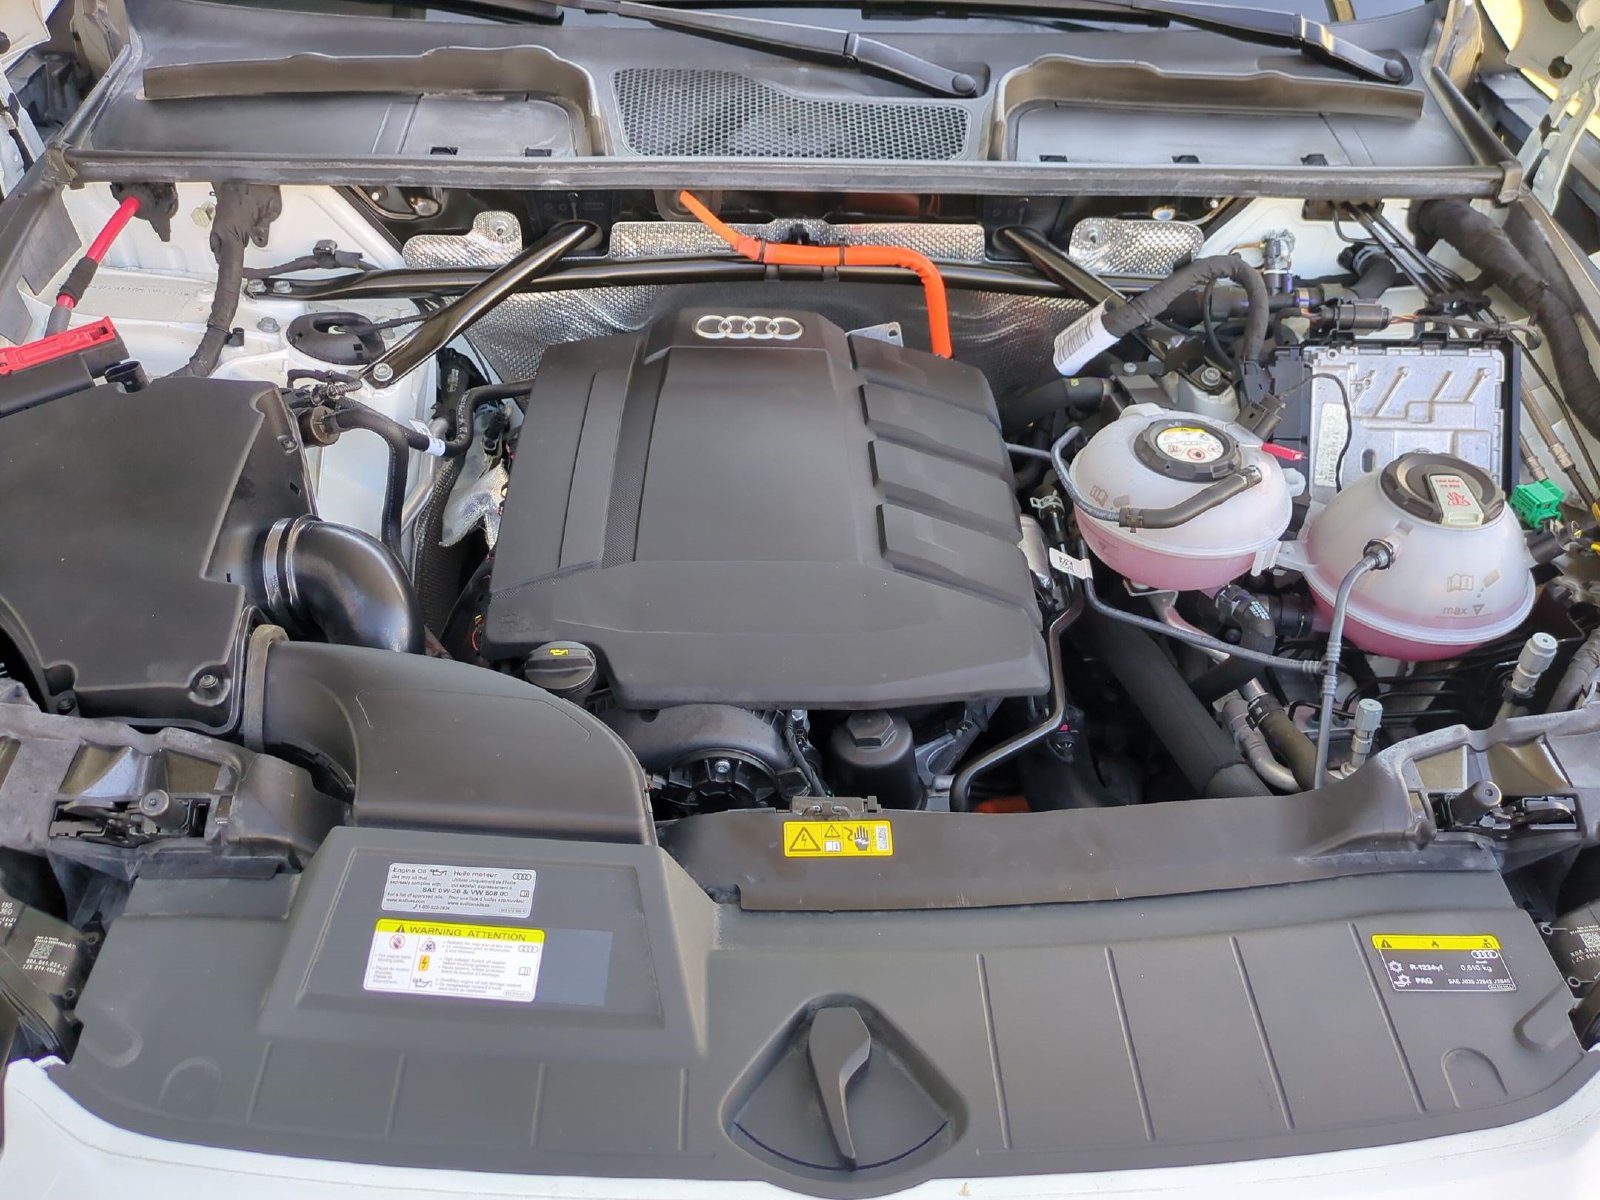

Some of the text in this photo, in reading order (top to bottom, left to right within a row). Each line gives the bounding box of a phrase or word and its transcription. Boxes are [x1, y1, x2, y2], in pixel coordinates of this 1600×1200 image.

[1442, 604, 1468, 615] max
[409, 926, 527, 941] WARNING ATTENTION
[1409, 963, 1444, 972] R-1234yf
[1481, 964, 1493, 973] kg
[1415, 977, 1433, 985] PAG
